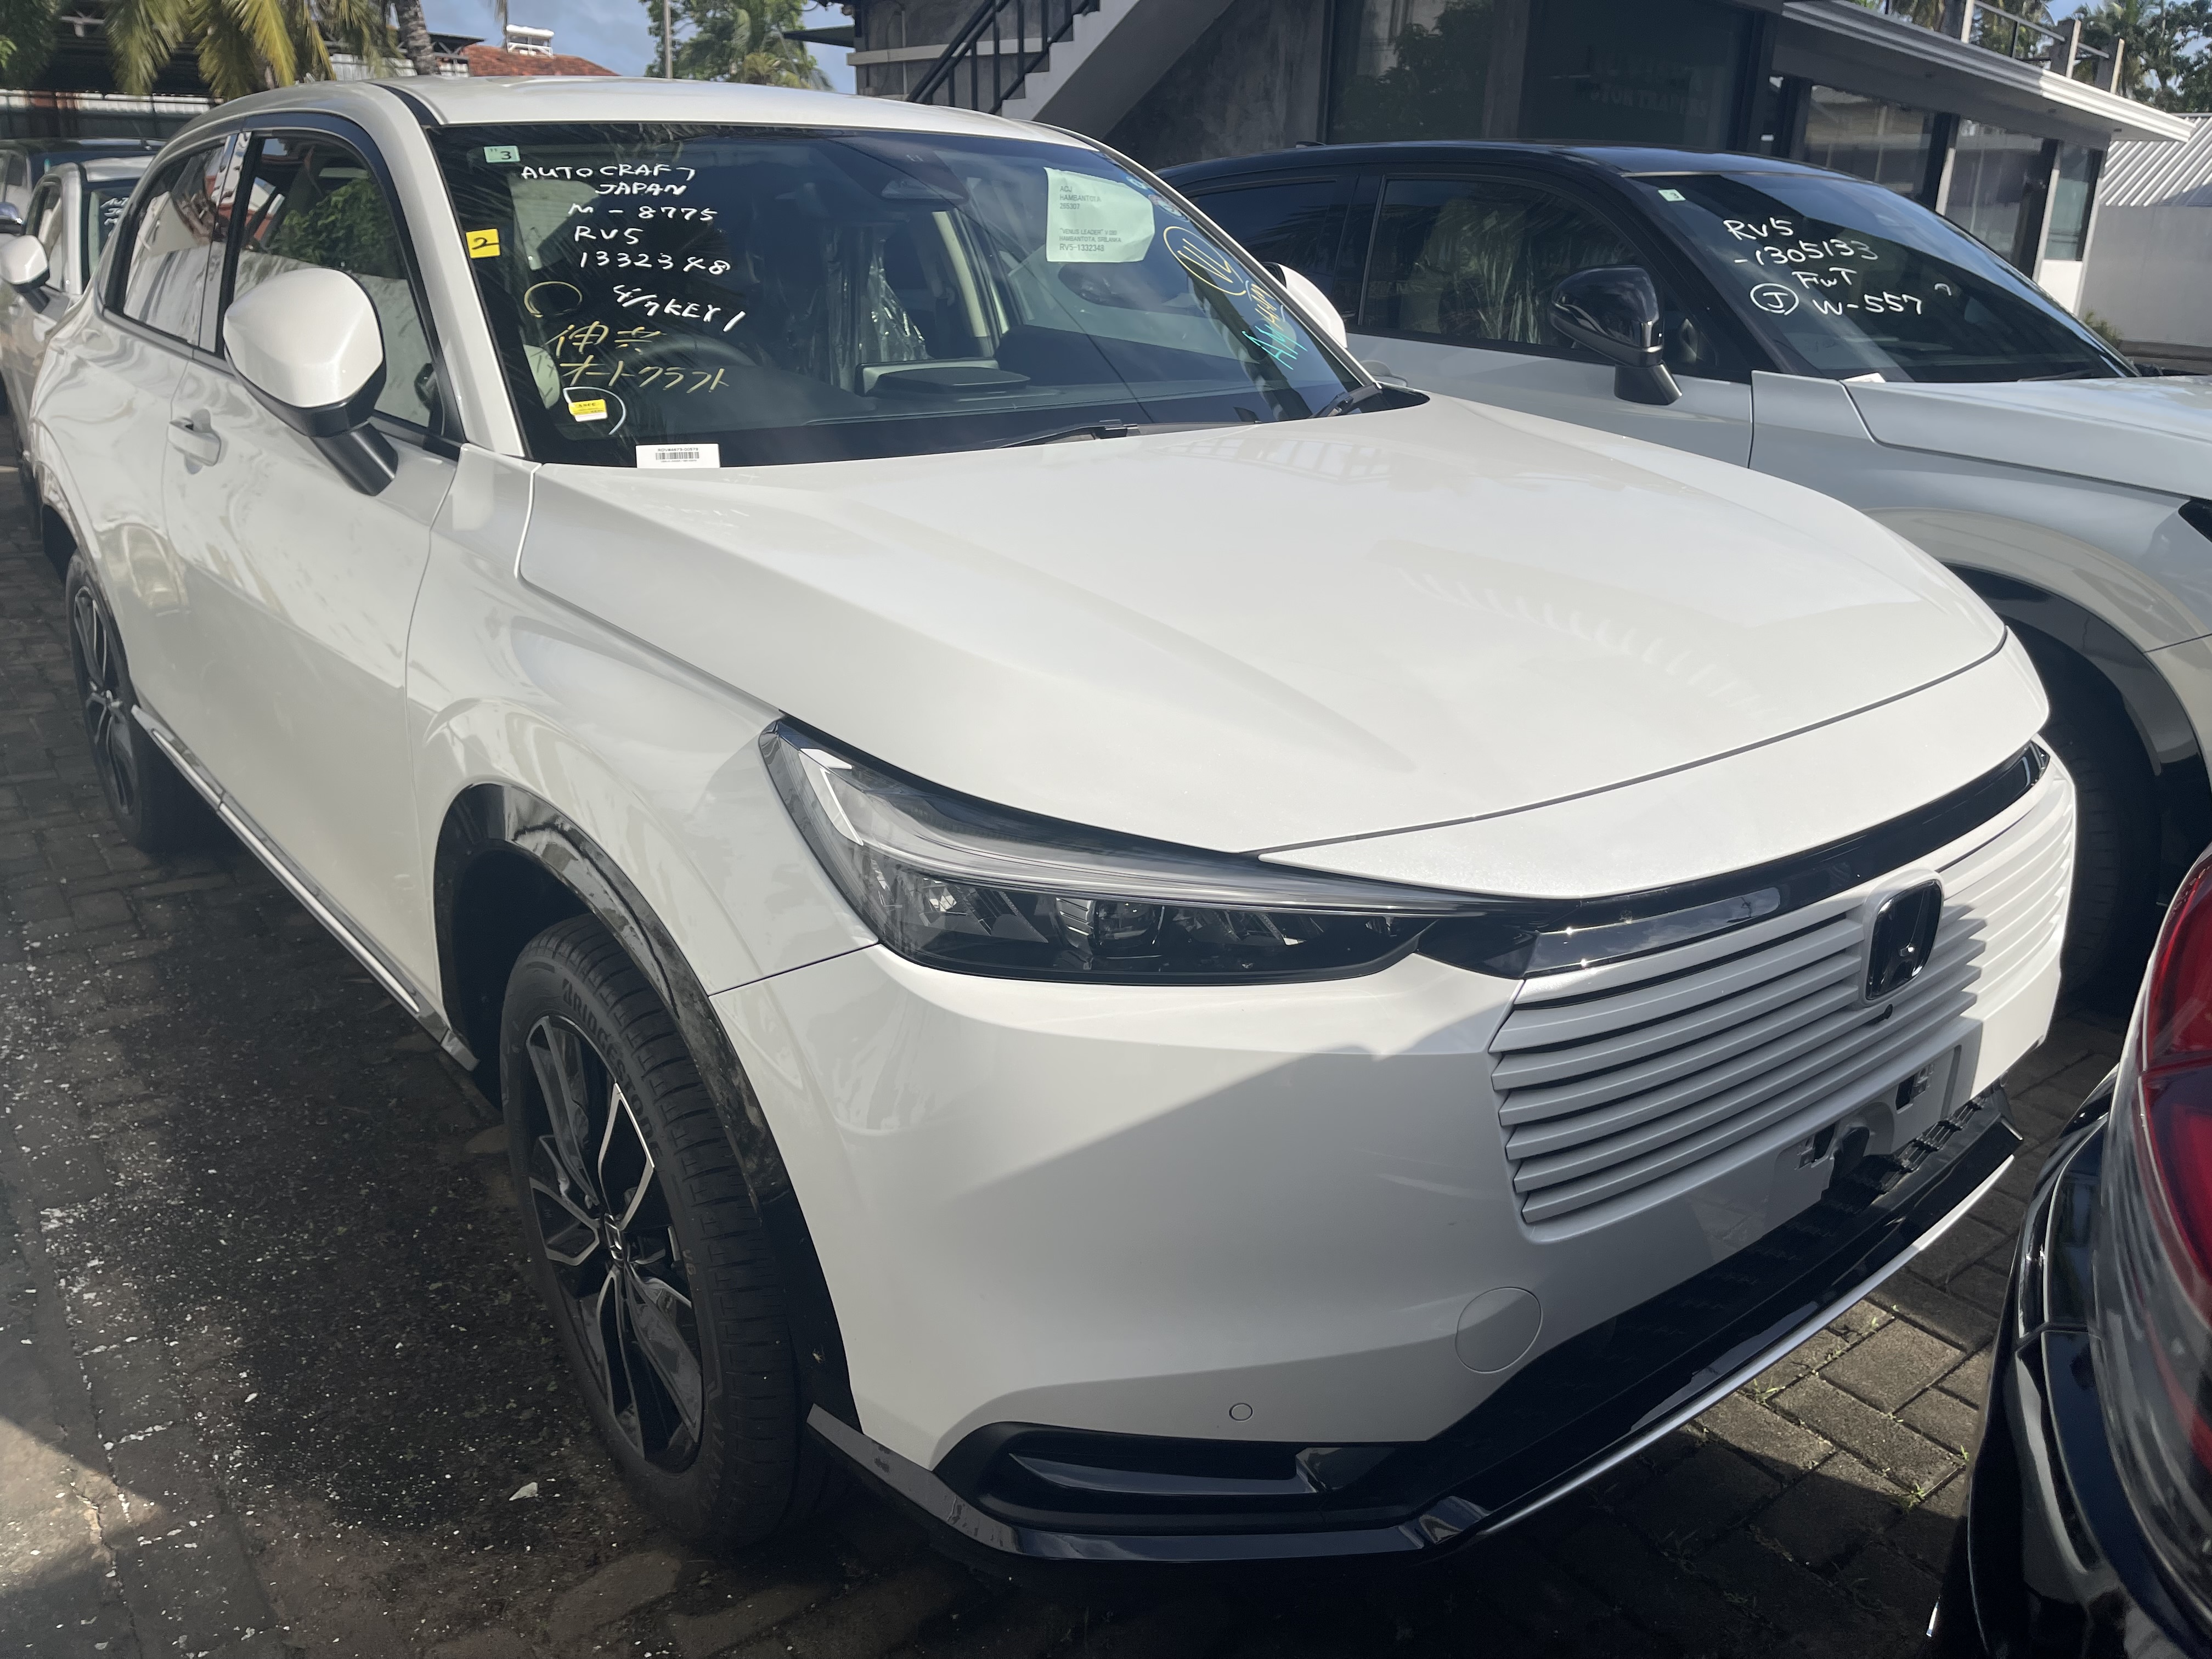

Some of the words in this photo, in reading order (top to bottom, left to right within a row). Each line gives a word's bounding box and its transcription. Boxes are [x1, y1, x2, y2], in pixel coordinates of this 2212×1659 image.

[500, 151, 511, 160] 3
[595, 182, 687, 196] JAPAN
[574, 225, 644, 245] RV5
[1723, 217, 1794, 240] RV5
[471, 236, 500, 250] 2
